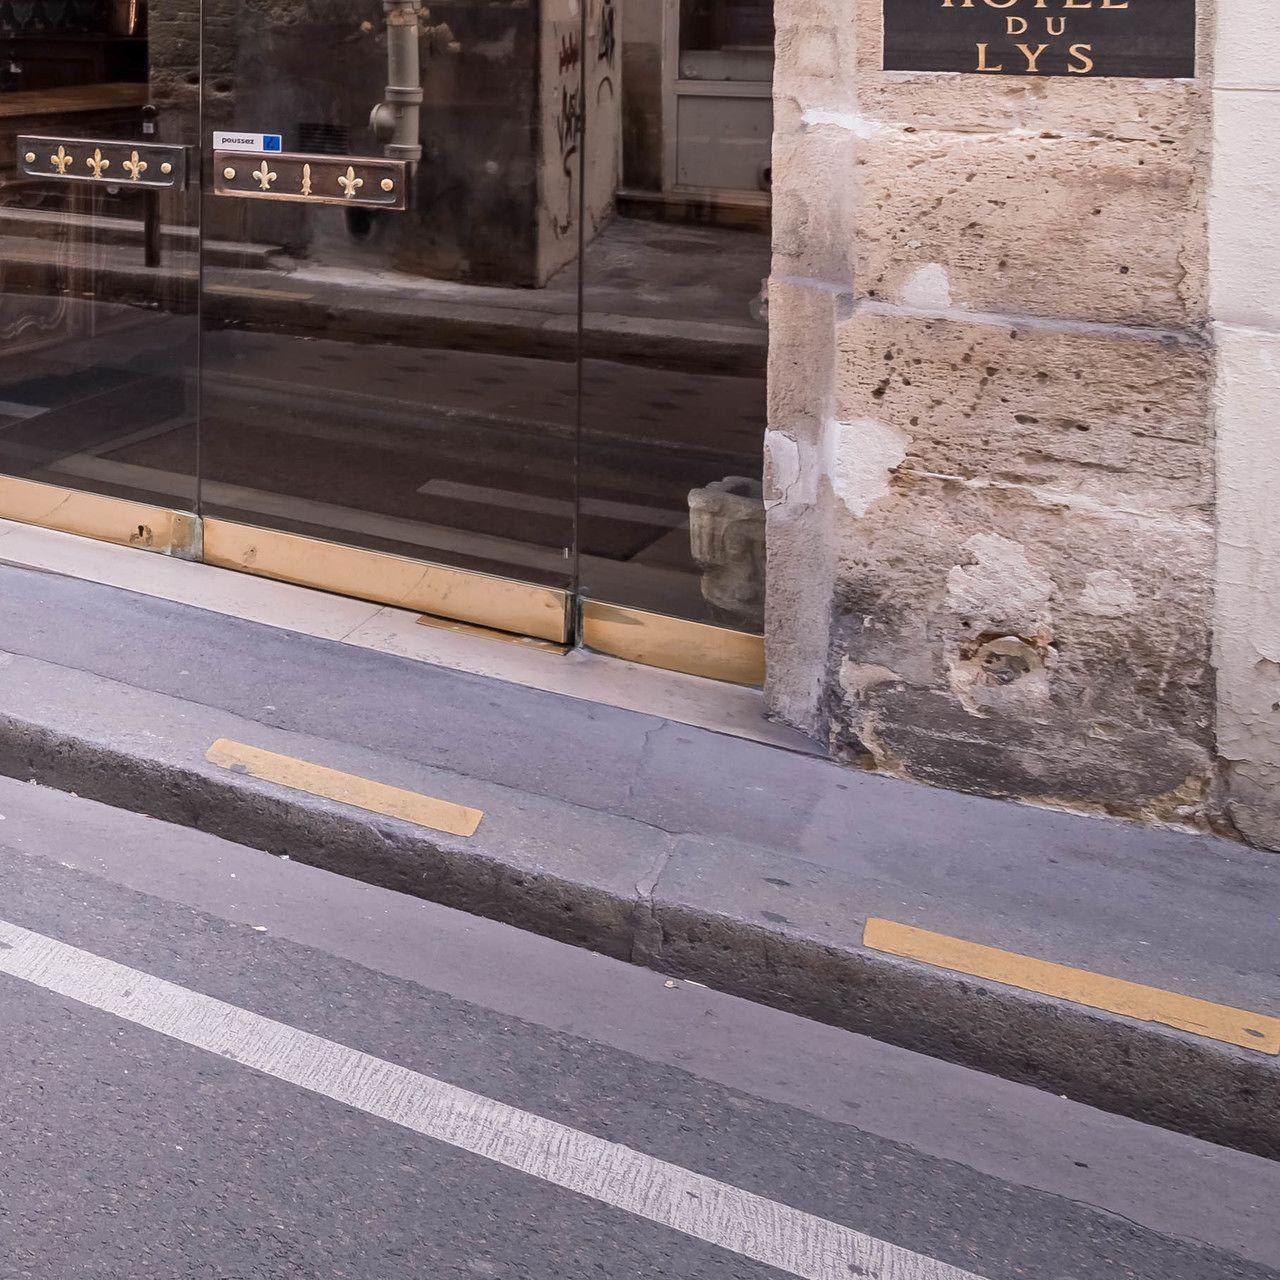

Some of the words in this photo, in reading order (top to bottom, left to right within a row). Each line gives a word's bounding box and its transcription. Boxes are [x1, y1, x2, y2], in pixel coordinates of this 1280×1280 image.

[1005, 16, 1067, 36] DU
[975, 42, 1095, 74] LYS
[221, 137, 255, 145] poussez
